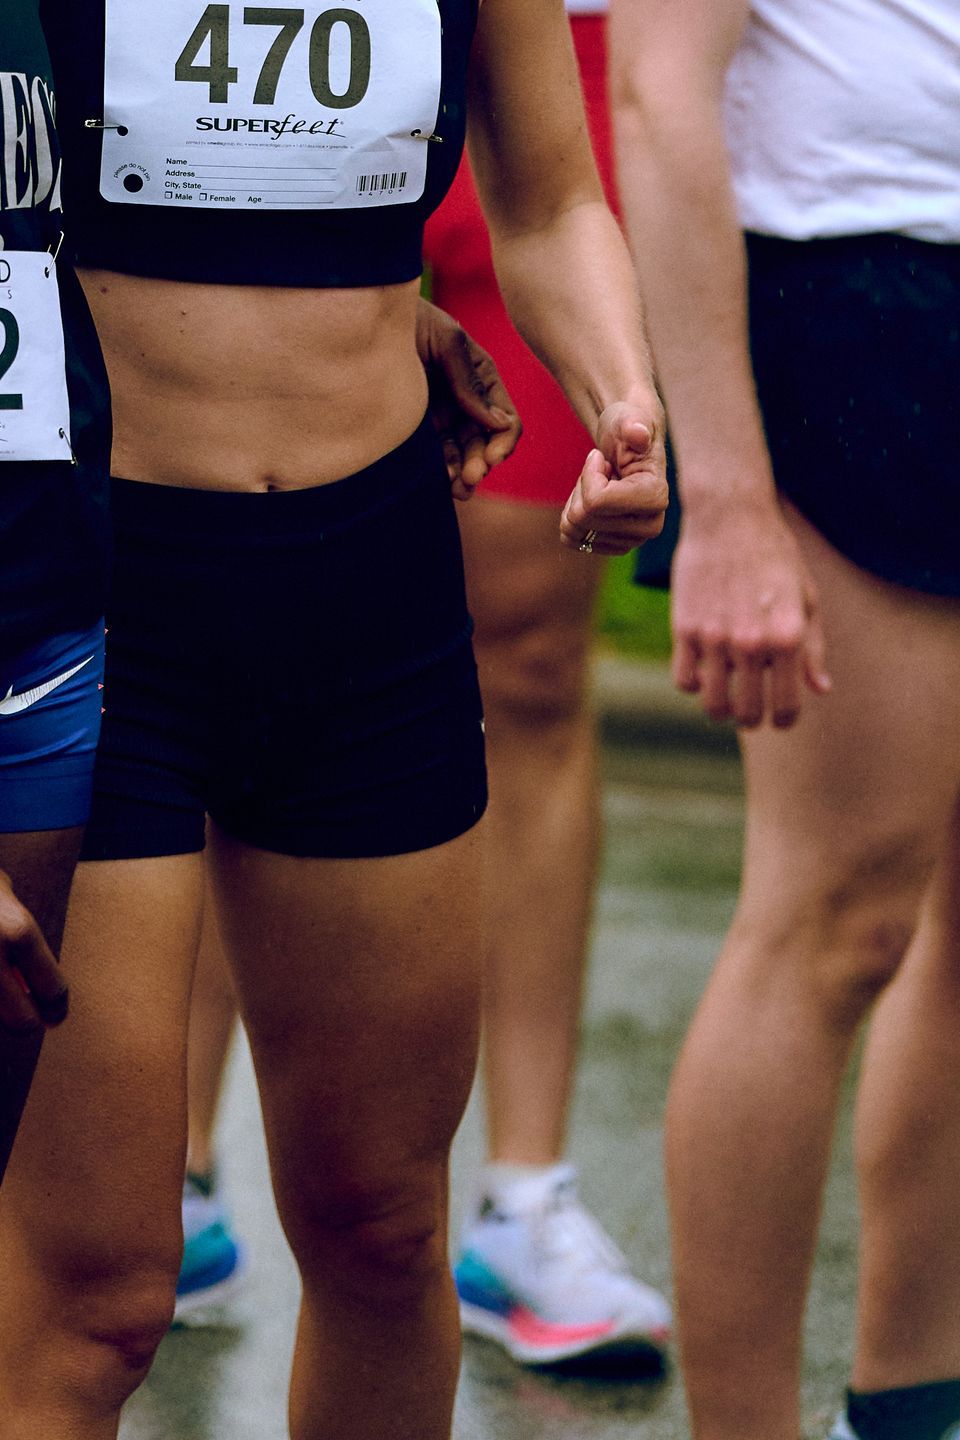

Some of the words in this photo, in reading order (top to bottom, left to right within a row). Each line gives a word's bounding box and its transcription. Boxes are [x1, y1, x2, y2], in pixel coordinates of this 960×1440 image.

[175, 4, 371, 110] 470
[196, 114, 346, 141] SUPERfeet
[137, 165, 147, 173] not
[164, 181, 181, 189] City,
[175, 193, 193, 201] Male
[209, 194, 236, 203] Female
[247, 195, 262, 204] Age
